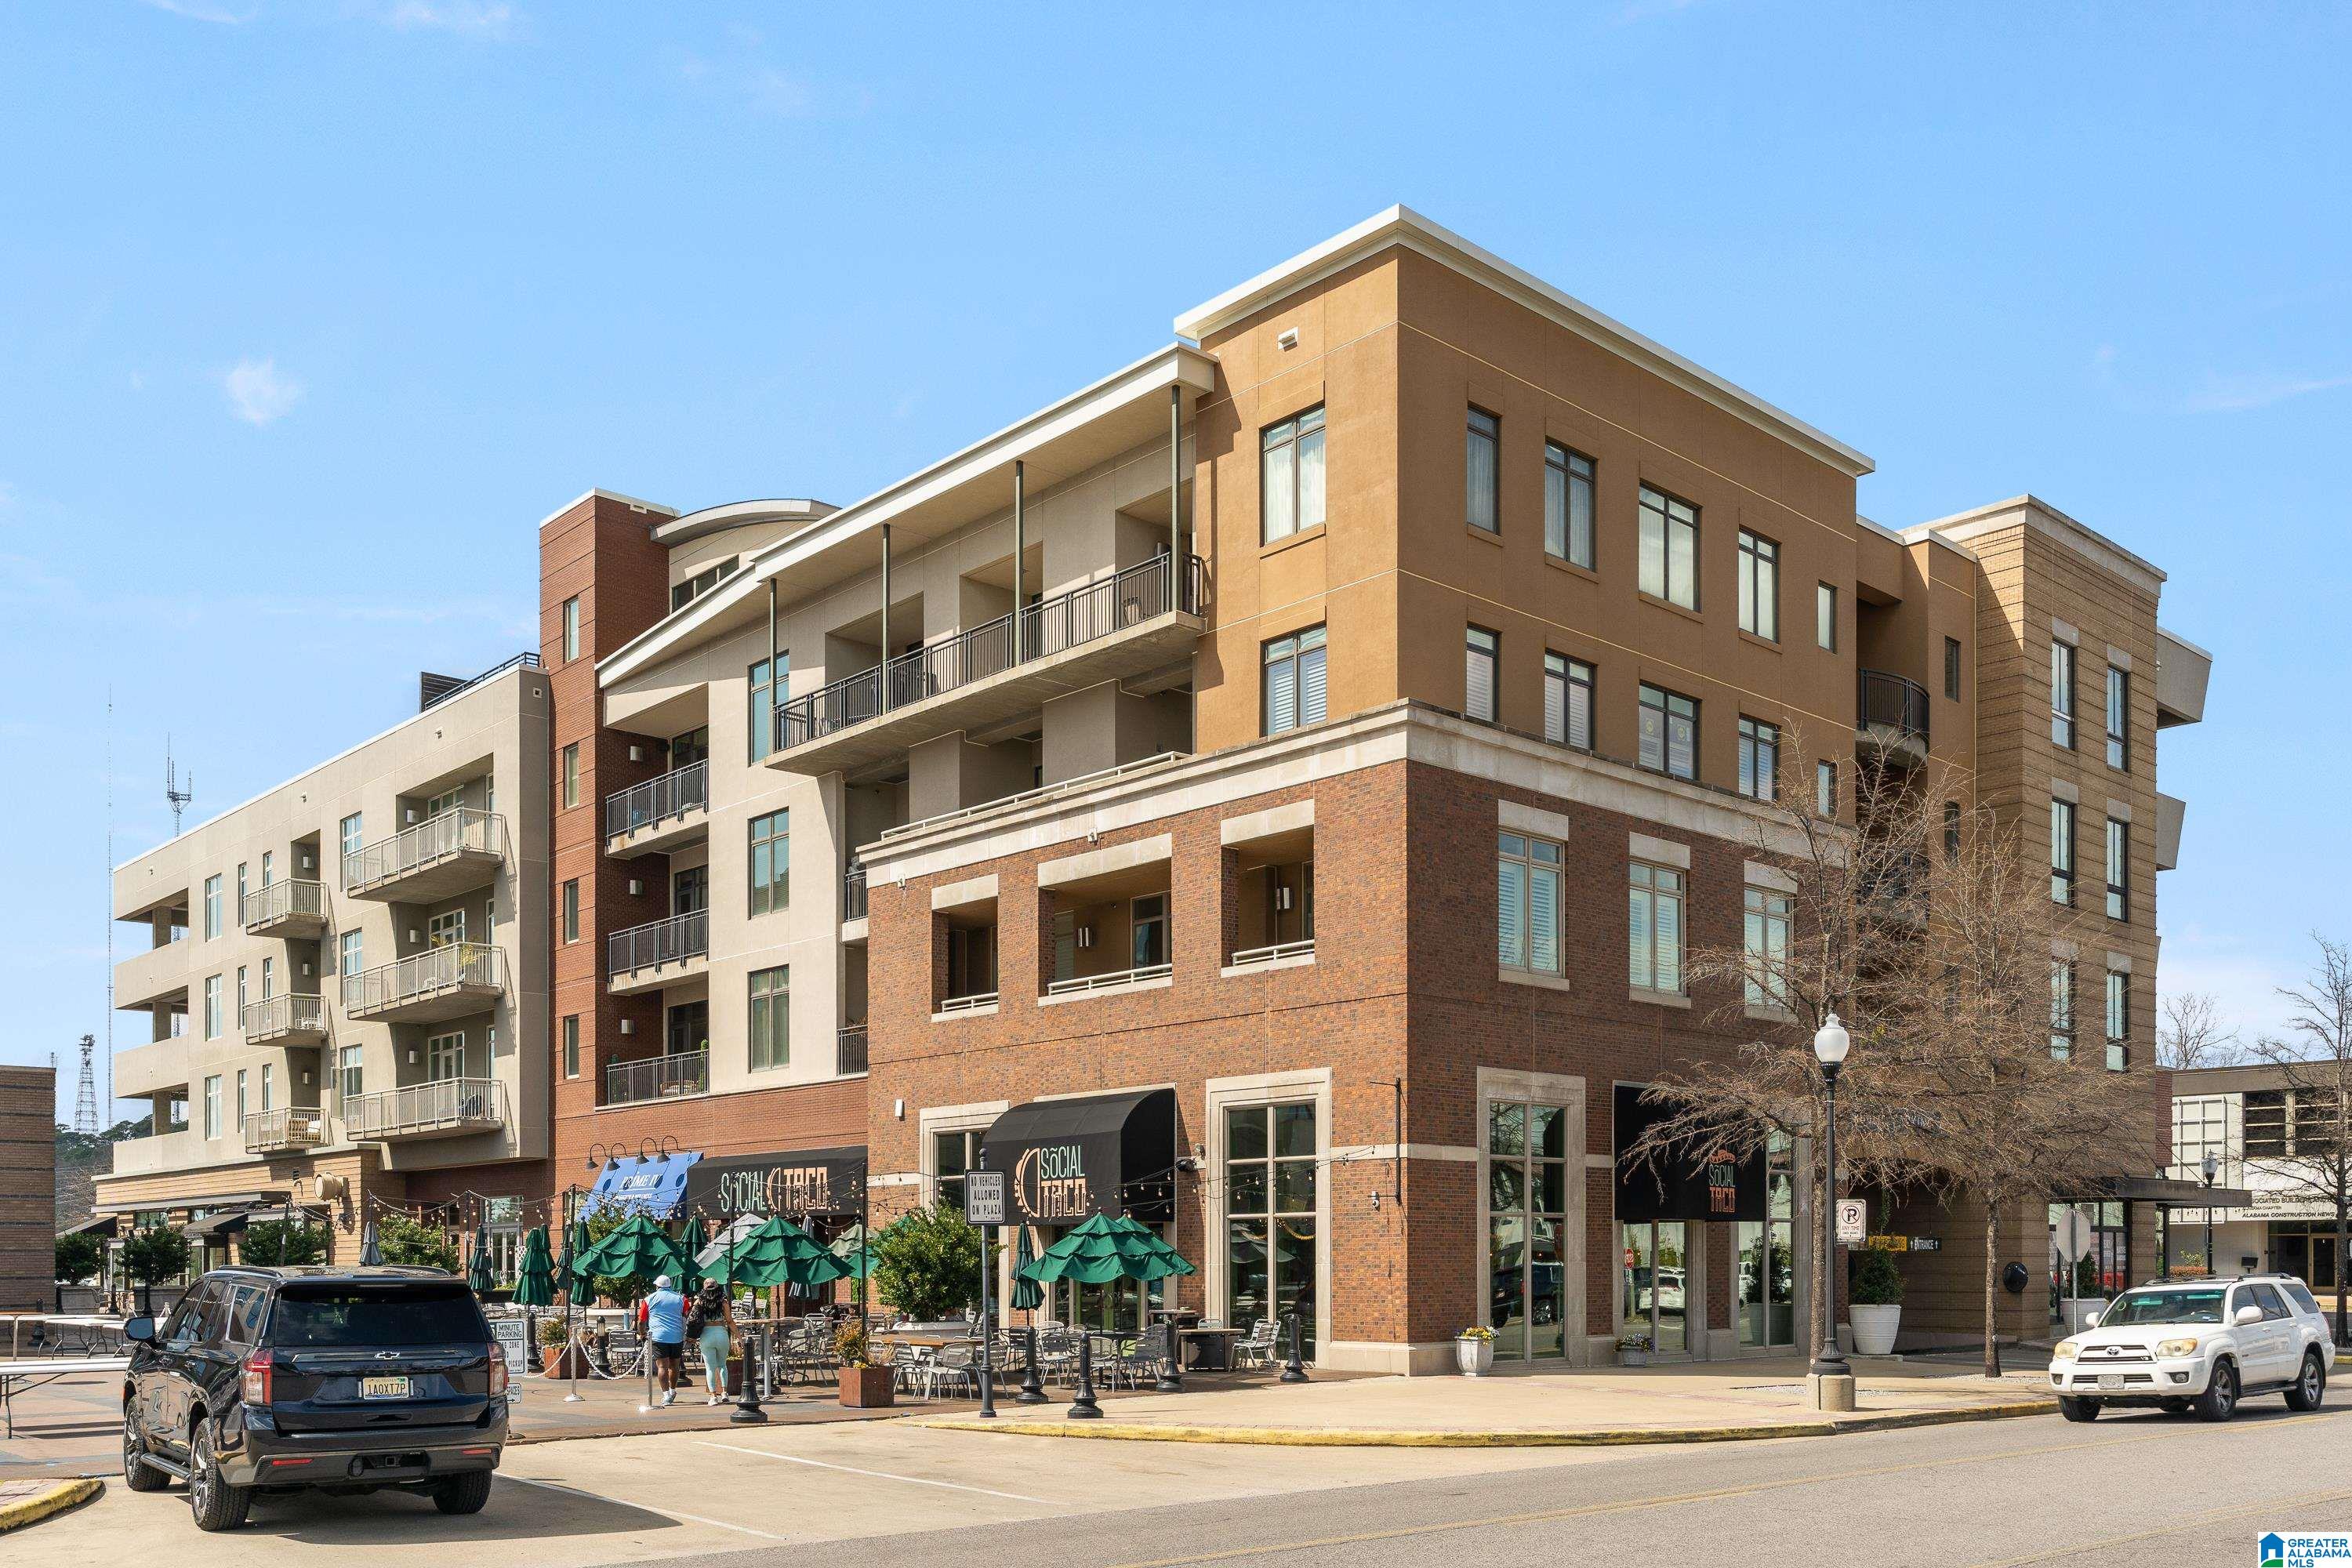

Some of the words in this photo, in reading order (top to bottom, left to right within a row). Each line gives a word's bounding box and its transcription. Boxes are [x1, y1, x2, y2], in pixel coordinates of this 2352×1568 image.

[971, 1176, 977, 1187] NO
[979, 1176, 1001, 1187] VEHICLES
[784, 1167, 828, 1210] TACO
[973, 1189, 1000, 1201] ALLOWED
[1040, 1178, 1087, 1218] TACO
[1709, 1186, 1735, 1213] TACO
[972, 1204, 980, 1215] ON
[983, 1204, 1002, 1215] PLAZA
[508, 1359, 523, 1368] PICKUP
